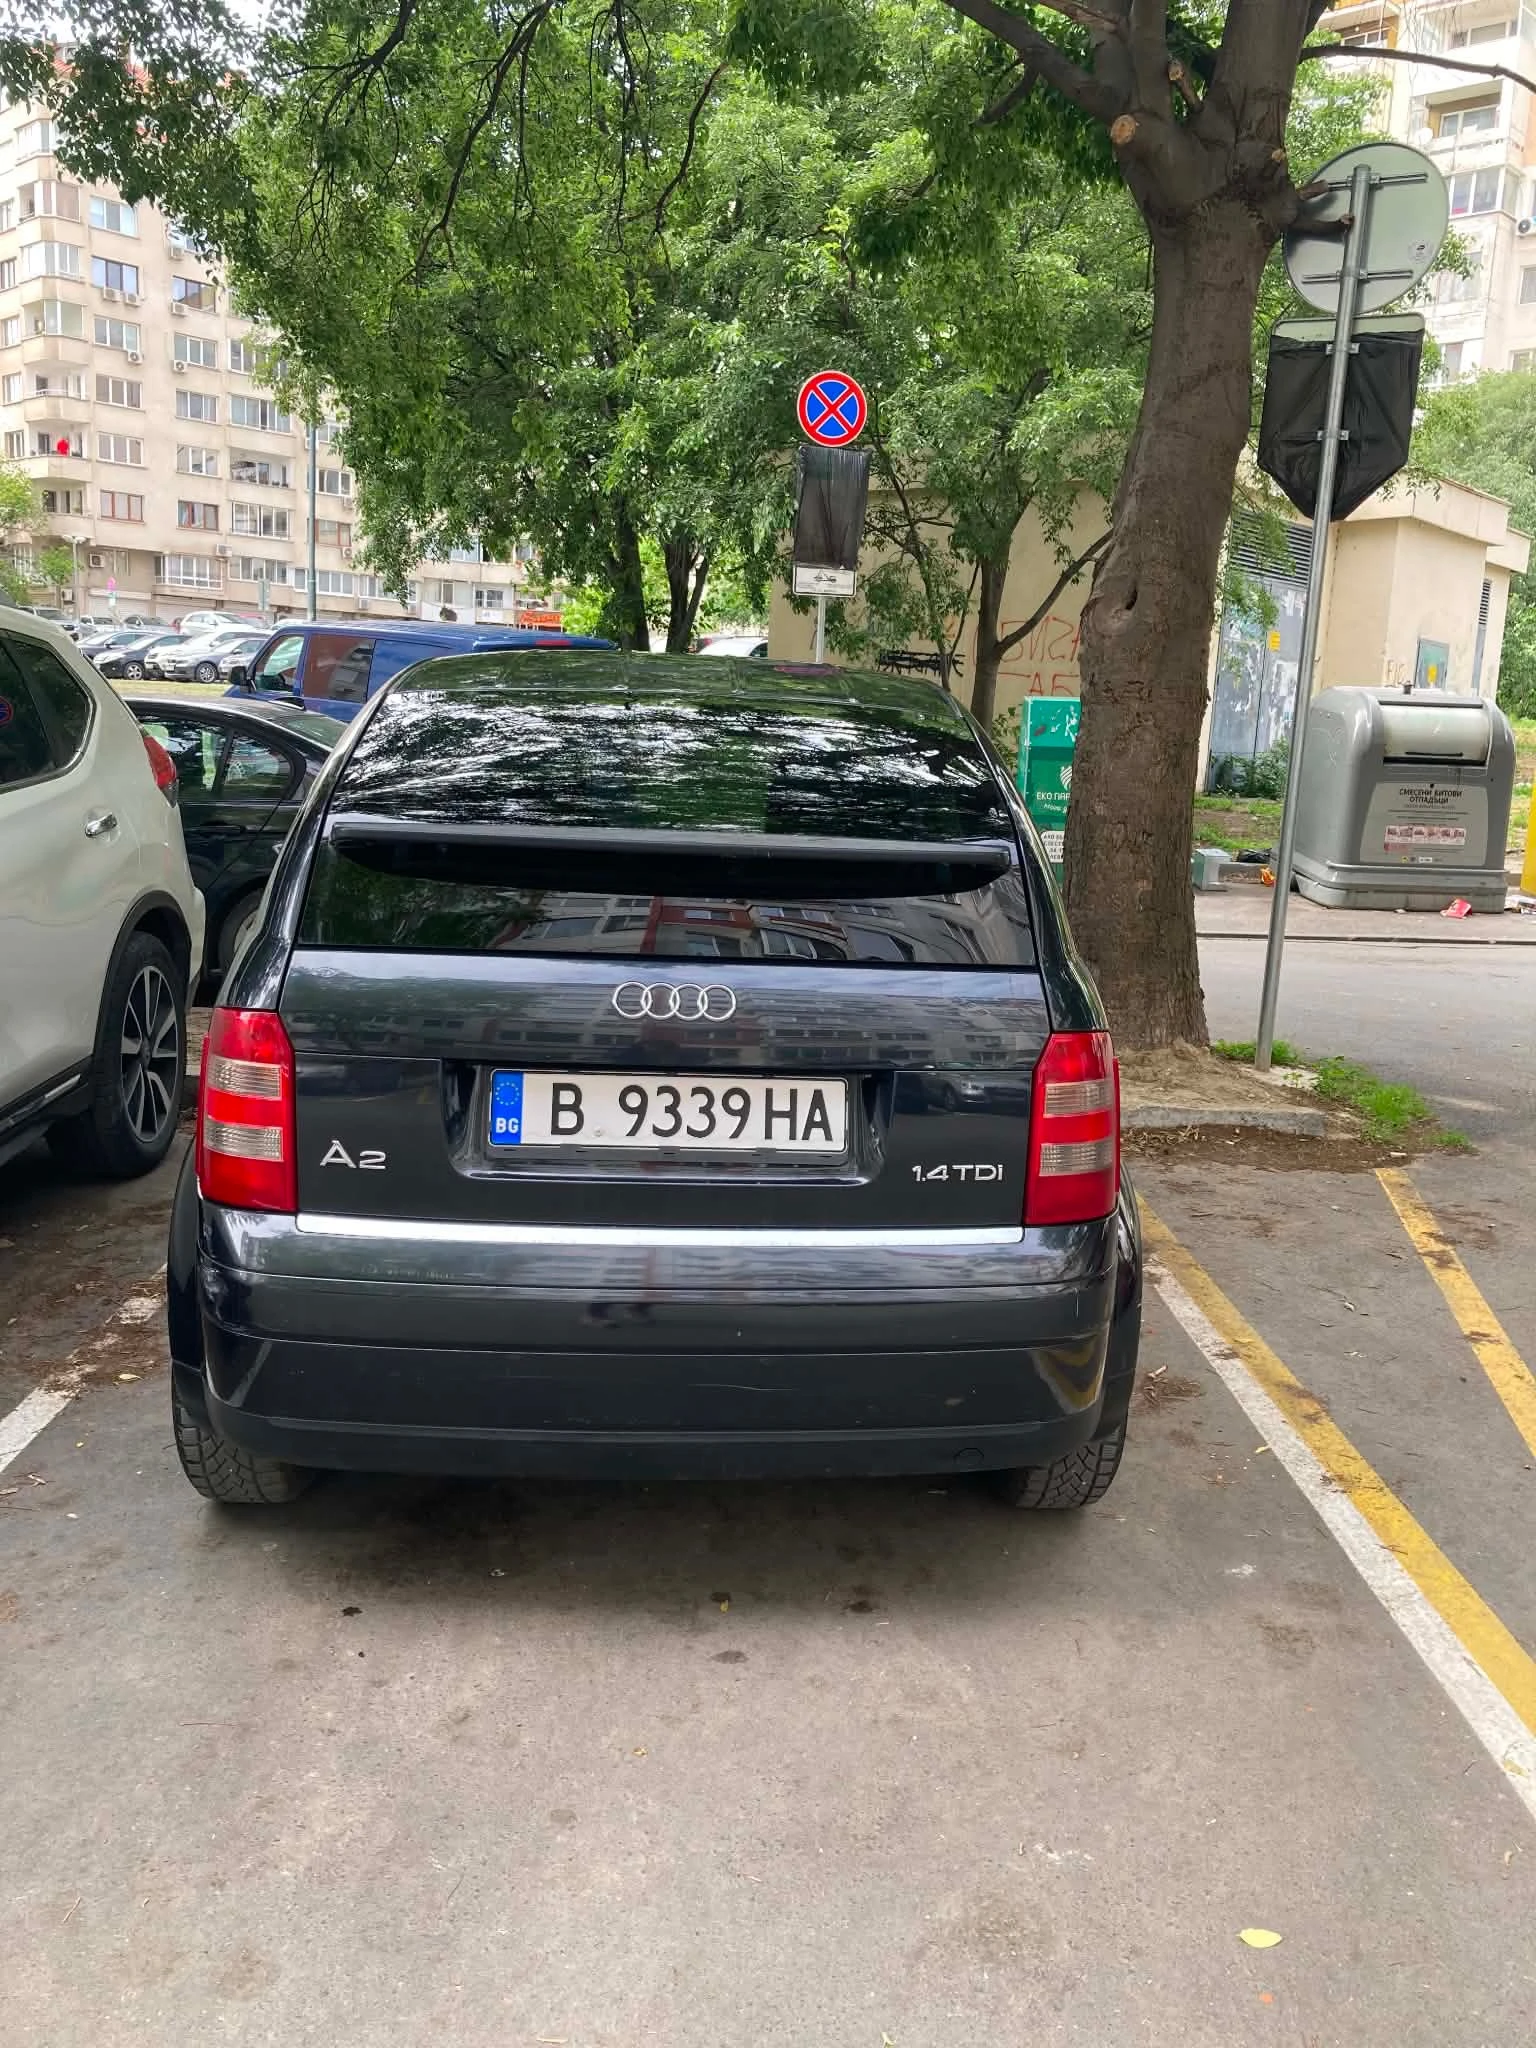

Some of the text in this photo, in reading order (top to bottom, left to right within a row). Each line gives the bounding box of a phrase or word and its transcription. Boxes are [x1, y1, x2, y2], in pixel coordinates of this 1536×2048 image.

[1036, 791, 1071, 801] ЕКО ПАР
[550, 1082, 585, 1136] B
[617, 1084, 752, 1140] 9339
[494, 1117, 520, 1134] BG
[319, 1139, 387, 1171] A2
